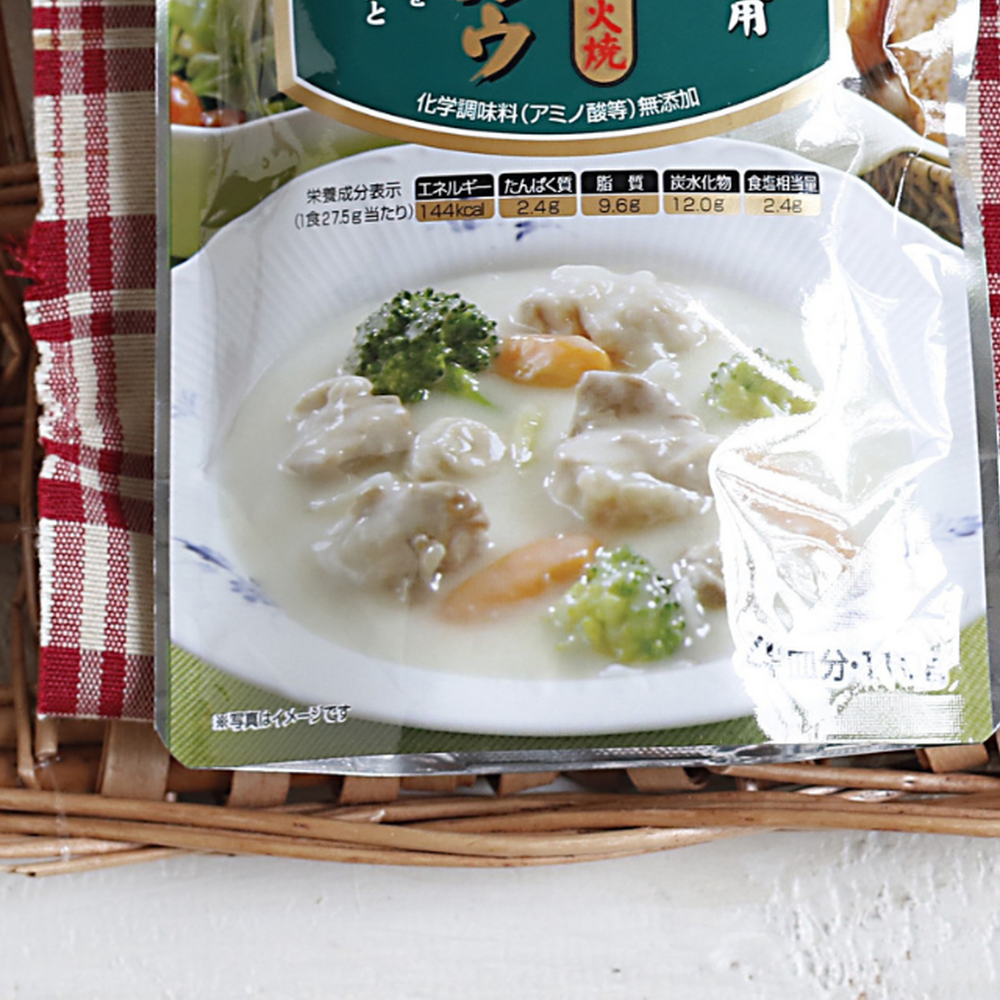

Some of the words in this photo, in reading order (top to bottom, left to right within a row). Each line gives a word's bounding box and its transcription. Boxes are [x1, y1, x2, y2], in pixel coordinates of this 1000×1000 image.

[416, 86, 701, 125] 化学調味料(アミノ酸等)無添加
[418, 178, 492, 197] エネルギー
[504, 175, 573, 195] たんぱく質
[670, 174, 732, 192] 炭水化物
[748, 174, 819, 194] 食塩相当量
[306, 181, 401, 205] 栄養成分表示
[420, 201, 485, 218] 144kcal
[517, 200, 560, 215] 2.4g
[598, 197, 641, 213] 9.6g
[673, 196, 725, 212] 12.0g
[763, 197, 802, 213] 2.4g
